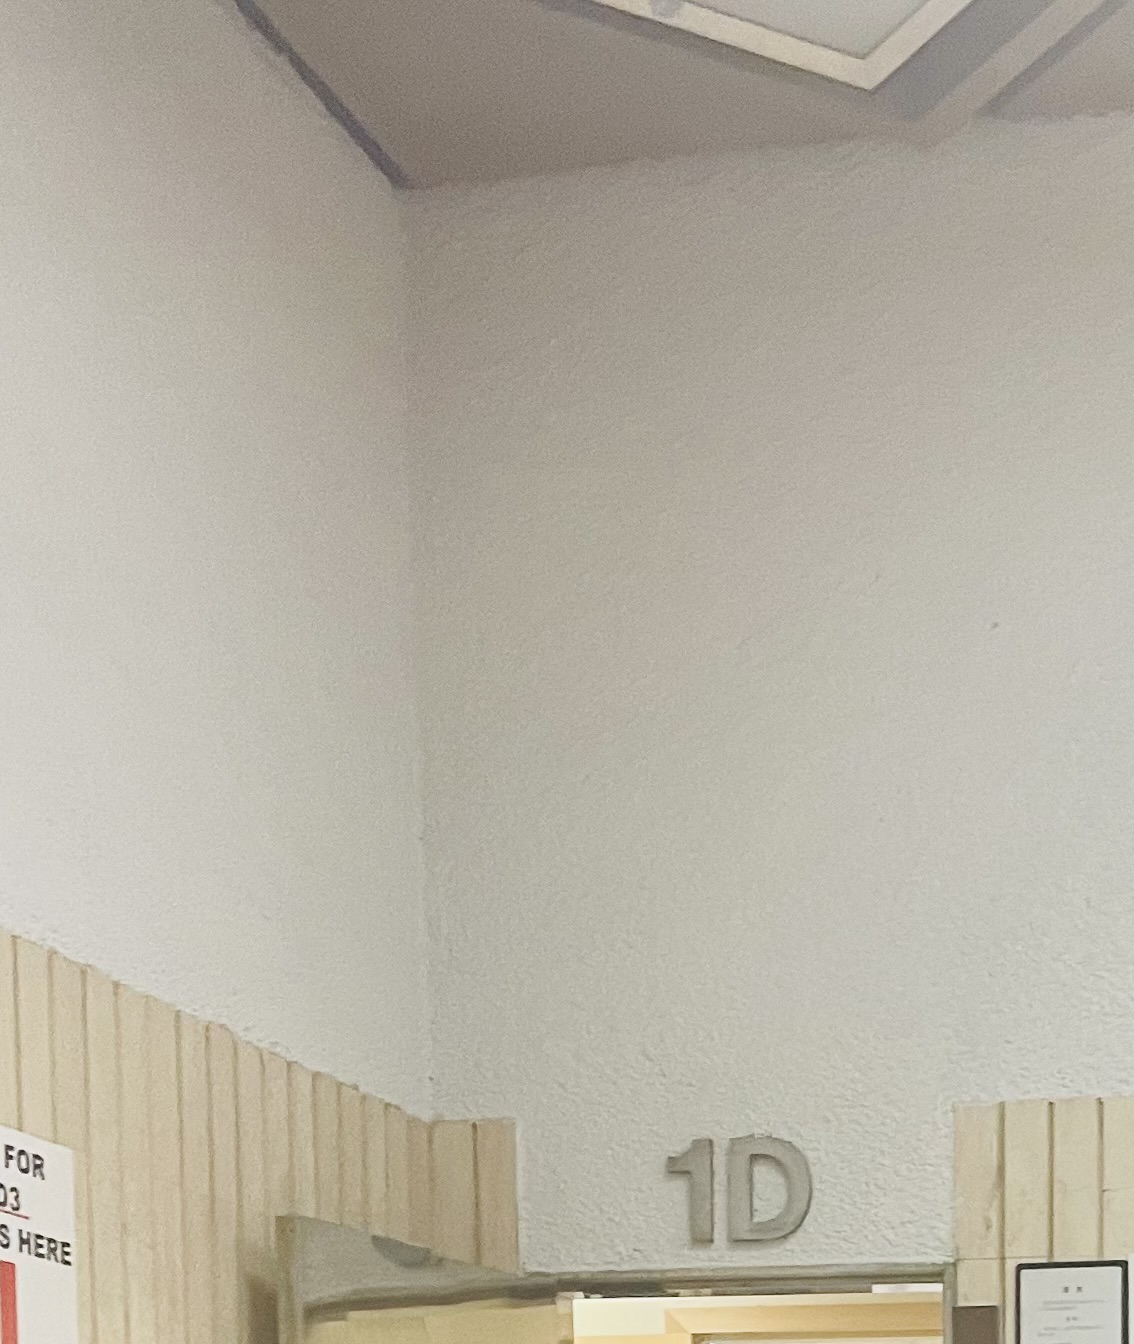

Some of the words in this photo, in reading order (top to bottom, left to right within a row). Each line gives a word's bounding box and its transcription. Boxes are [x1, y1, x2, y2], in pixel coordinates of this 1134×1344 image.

[4, 1143, 45, 1181] FOR
[665, 1134, 812, 1244] 1D
[18, 1228, 72, 1266] HERE
